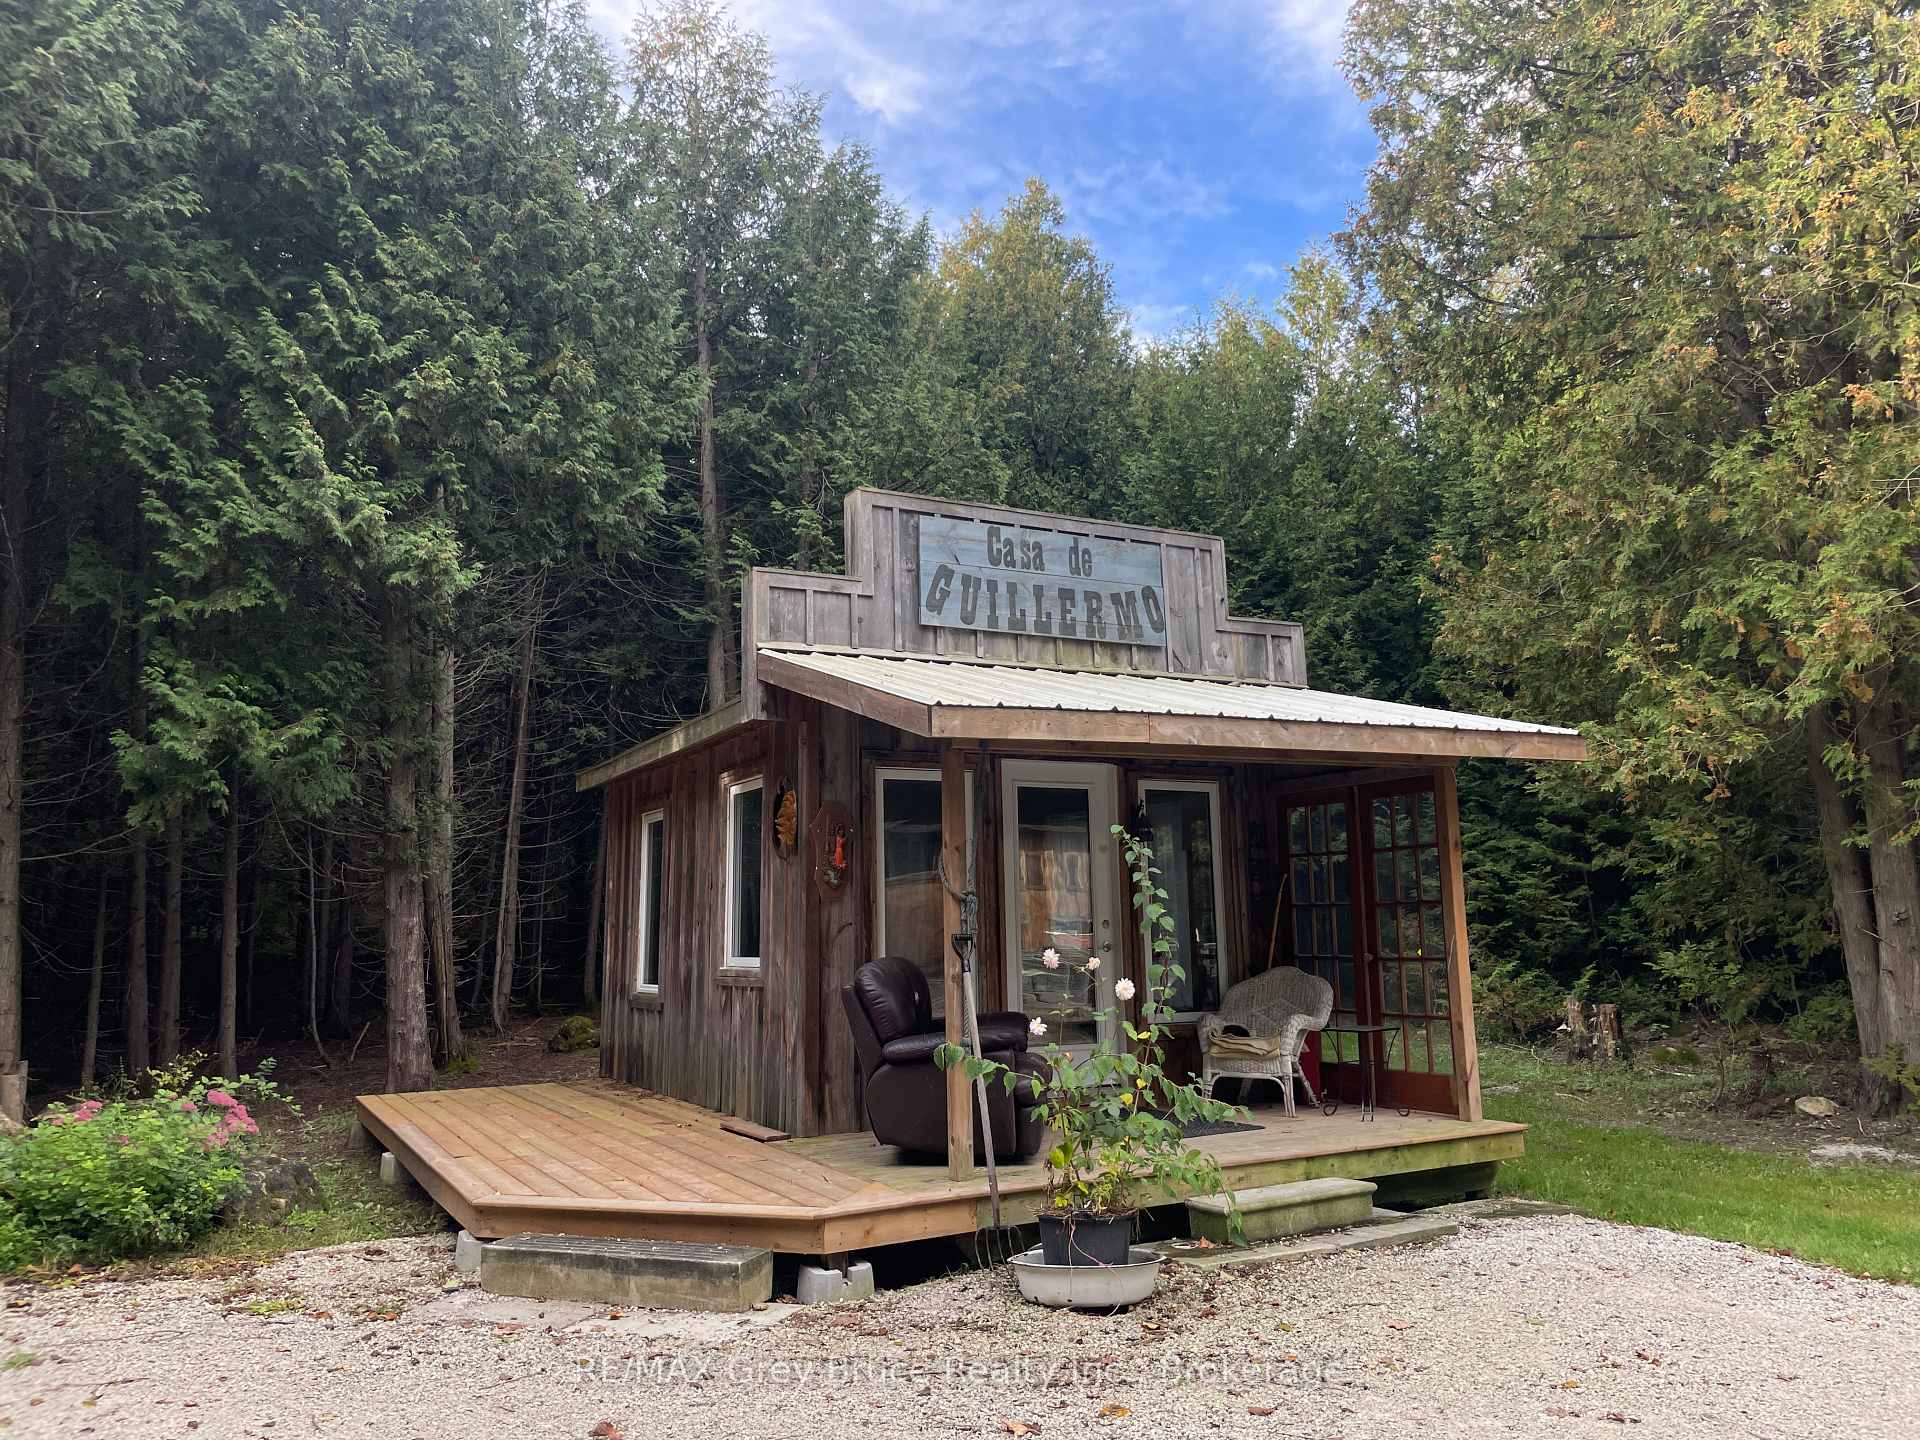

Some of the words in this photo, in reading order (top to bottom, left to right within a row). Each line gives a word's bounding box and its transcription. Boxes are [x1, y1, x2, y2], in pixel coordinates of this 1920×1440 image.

[986, 524, 1046, 572] Casa
[1068, 536, 1093, 577] de
[925, 563, 1165, 641] GUILLERMO
